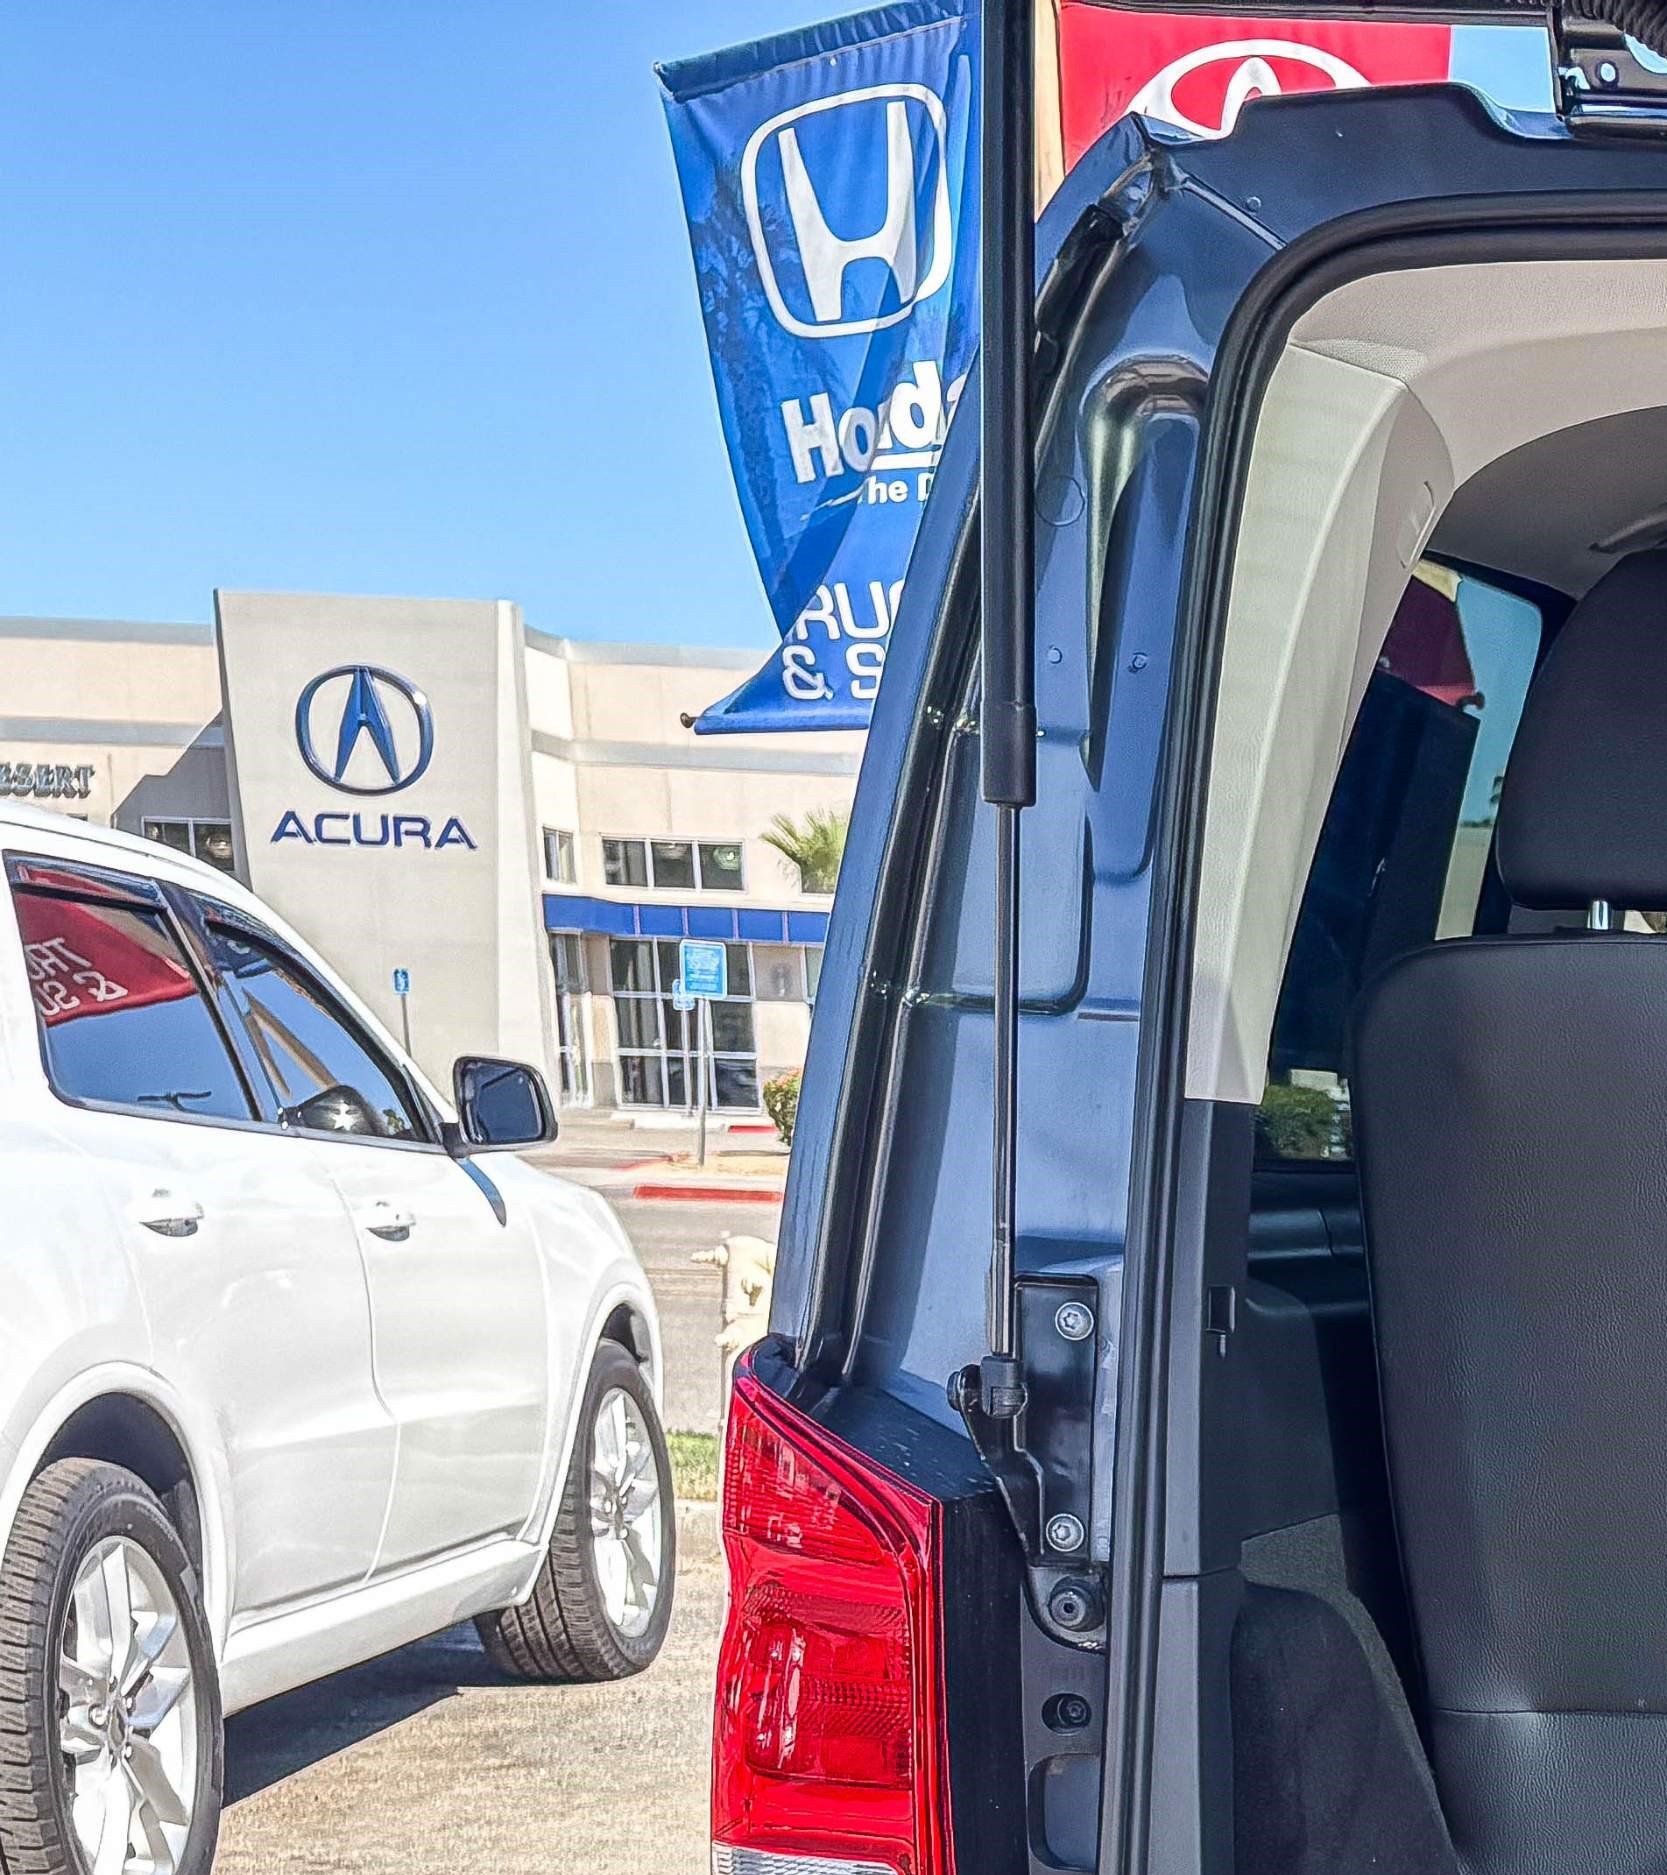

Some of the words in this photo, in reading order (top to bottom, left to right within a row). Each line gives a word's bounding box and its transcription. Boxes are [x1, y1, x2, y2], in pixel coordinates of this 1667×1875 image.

[857, 475, 909, 505] he
[782, 645, 833, 700] &
[270, 810, 478, 850] ACURA
